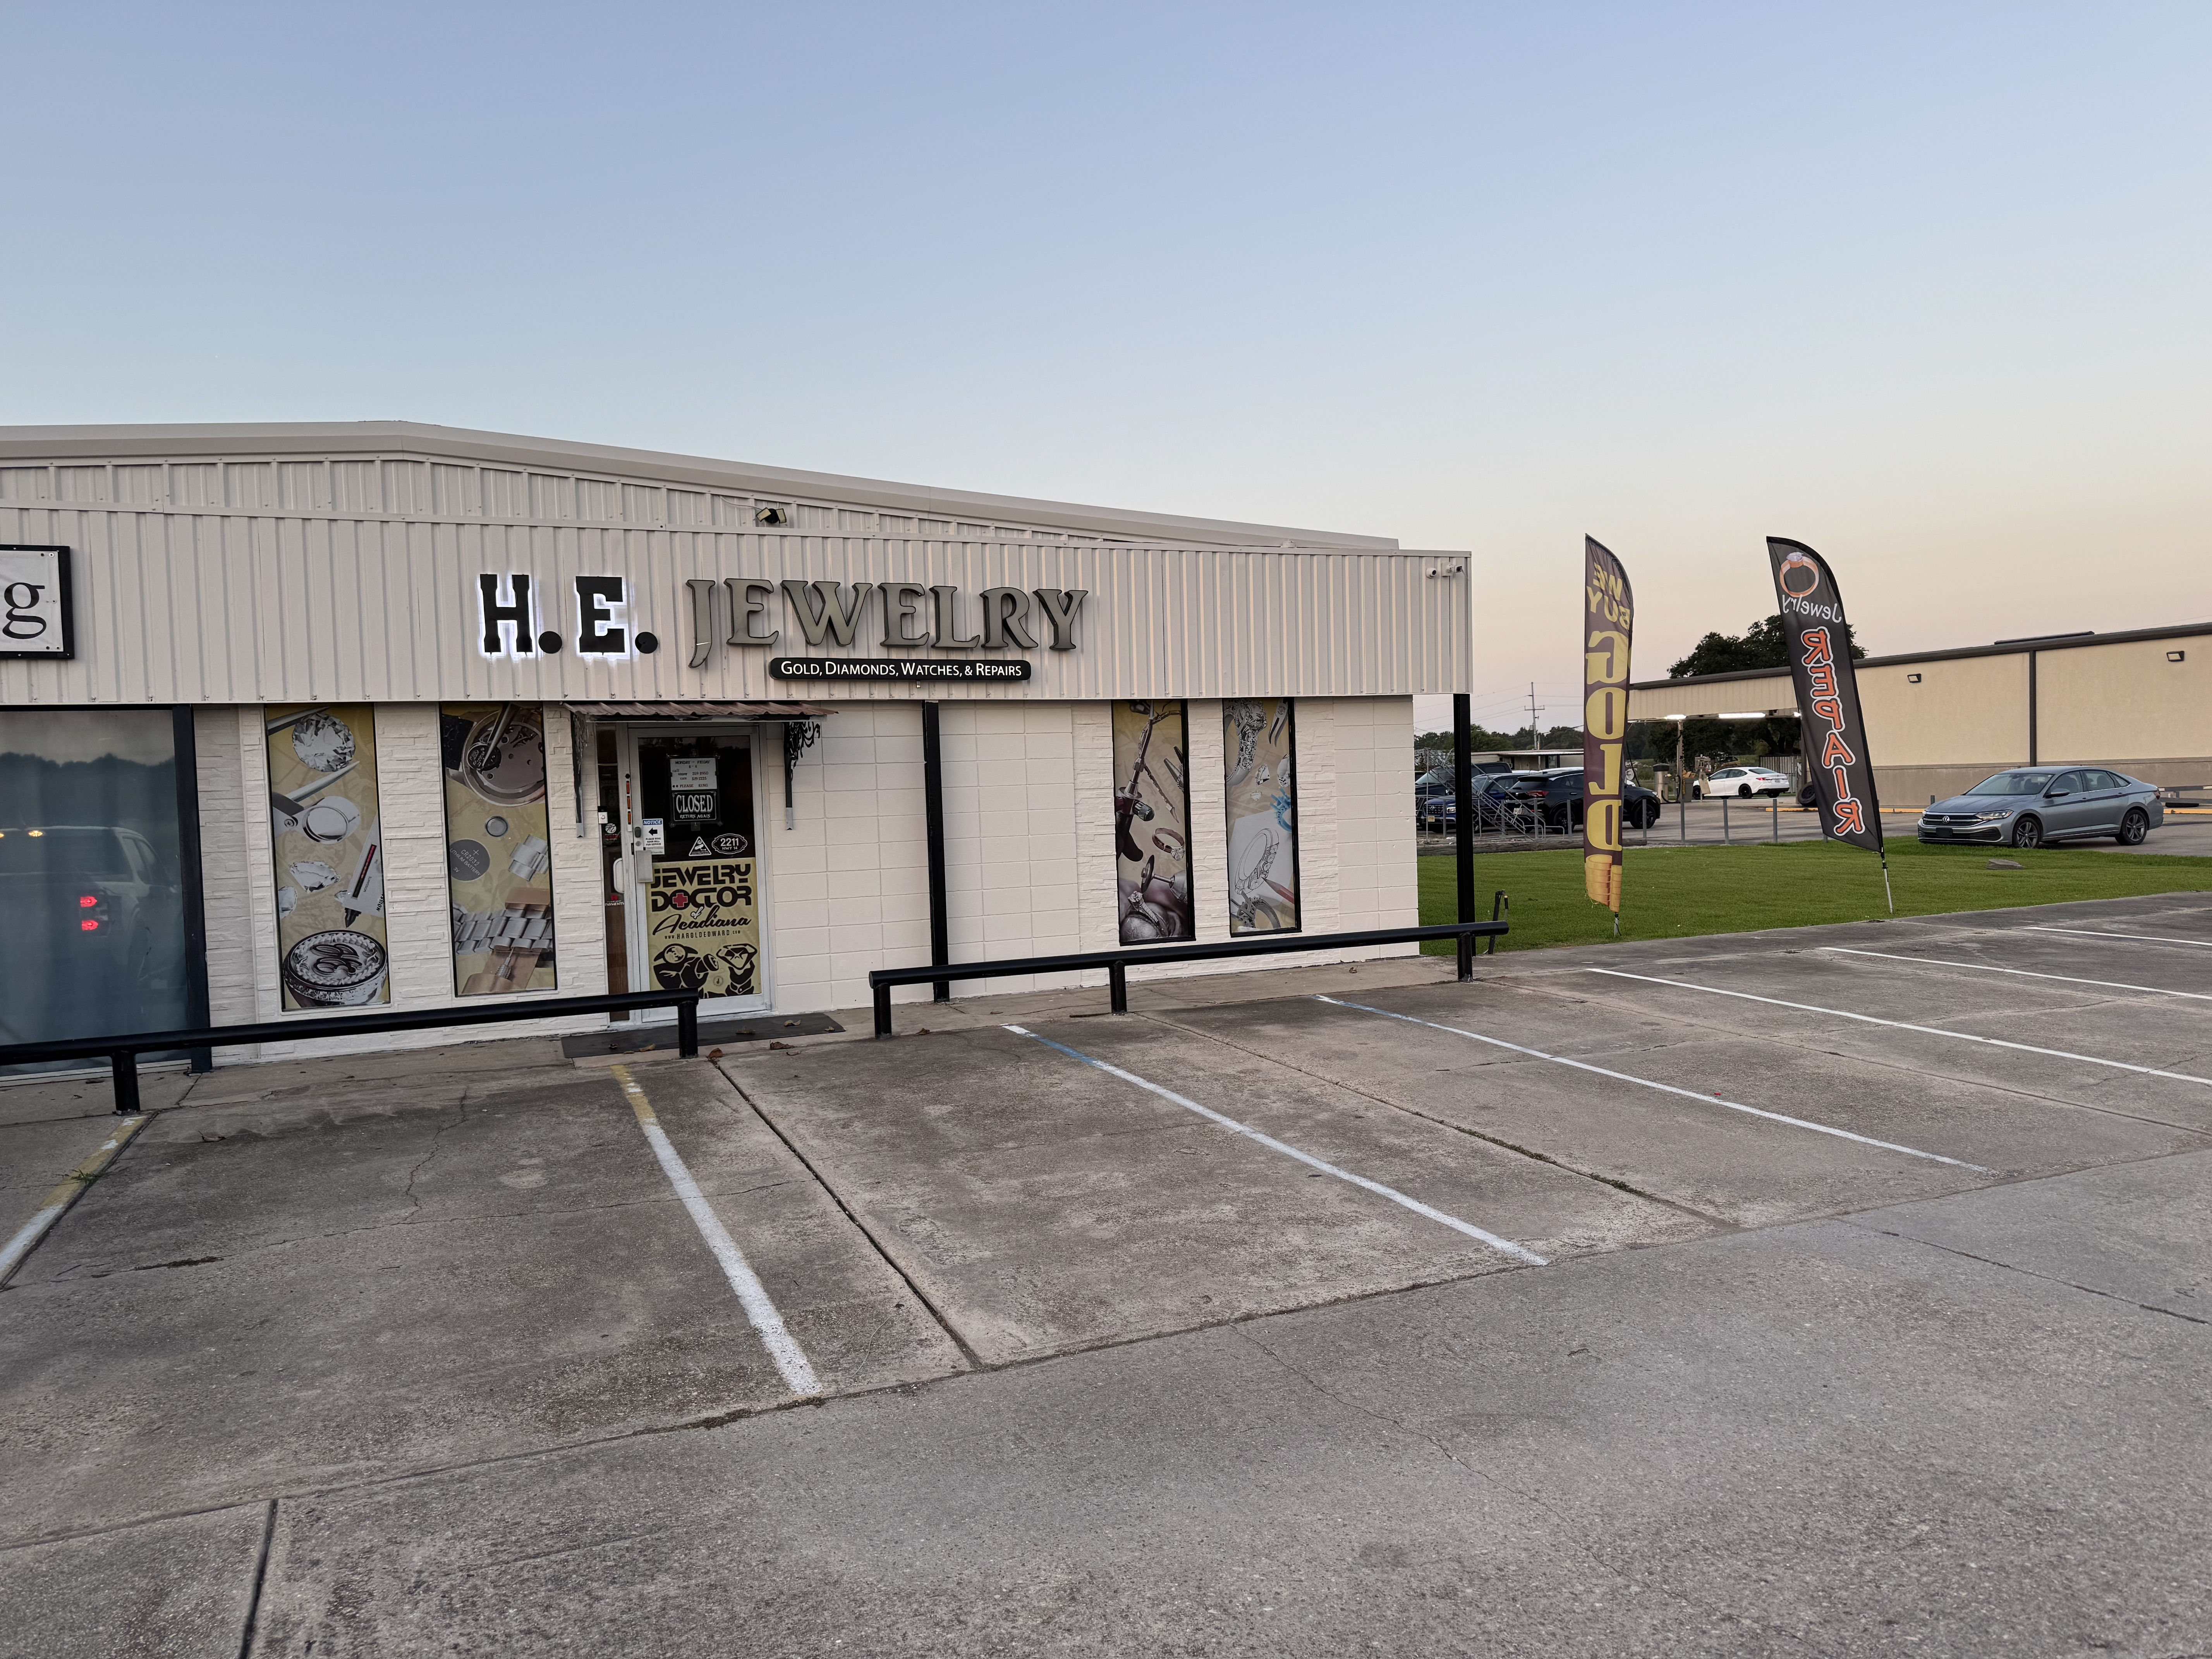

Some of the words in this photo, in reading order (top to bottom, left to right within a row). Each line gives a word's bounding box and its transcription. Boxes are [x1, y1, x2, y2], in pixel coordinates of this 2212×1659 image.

[479, 574, 658, 654] H.E.
[685, 578, 1089, 668] JEWELRY
[781, 661, 823, 677] GOLD,
[825, 661, 898, 677] DIAMONDS,
[901, 662, 962, 677] WATCHES,
[965, 665, 973, 676] &
[976, 663, 1022, 677] REPAIRS
[676, 795, 713, 813] CLOSED
[720, 838, 739, 846] 2211
[450, 848, 465, 862] LITHIUM
[461, 849, 480, 866] CR2032
[464, 861, 481, 875] BATTERY
[651, 863, 751, 888] JEWELRY
[651, 885, 752, 912] DOCTOR
[652, 905, 752, 936] Acadiana
[690, 906, 704, 919] of
